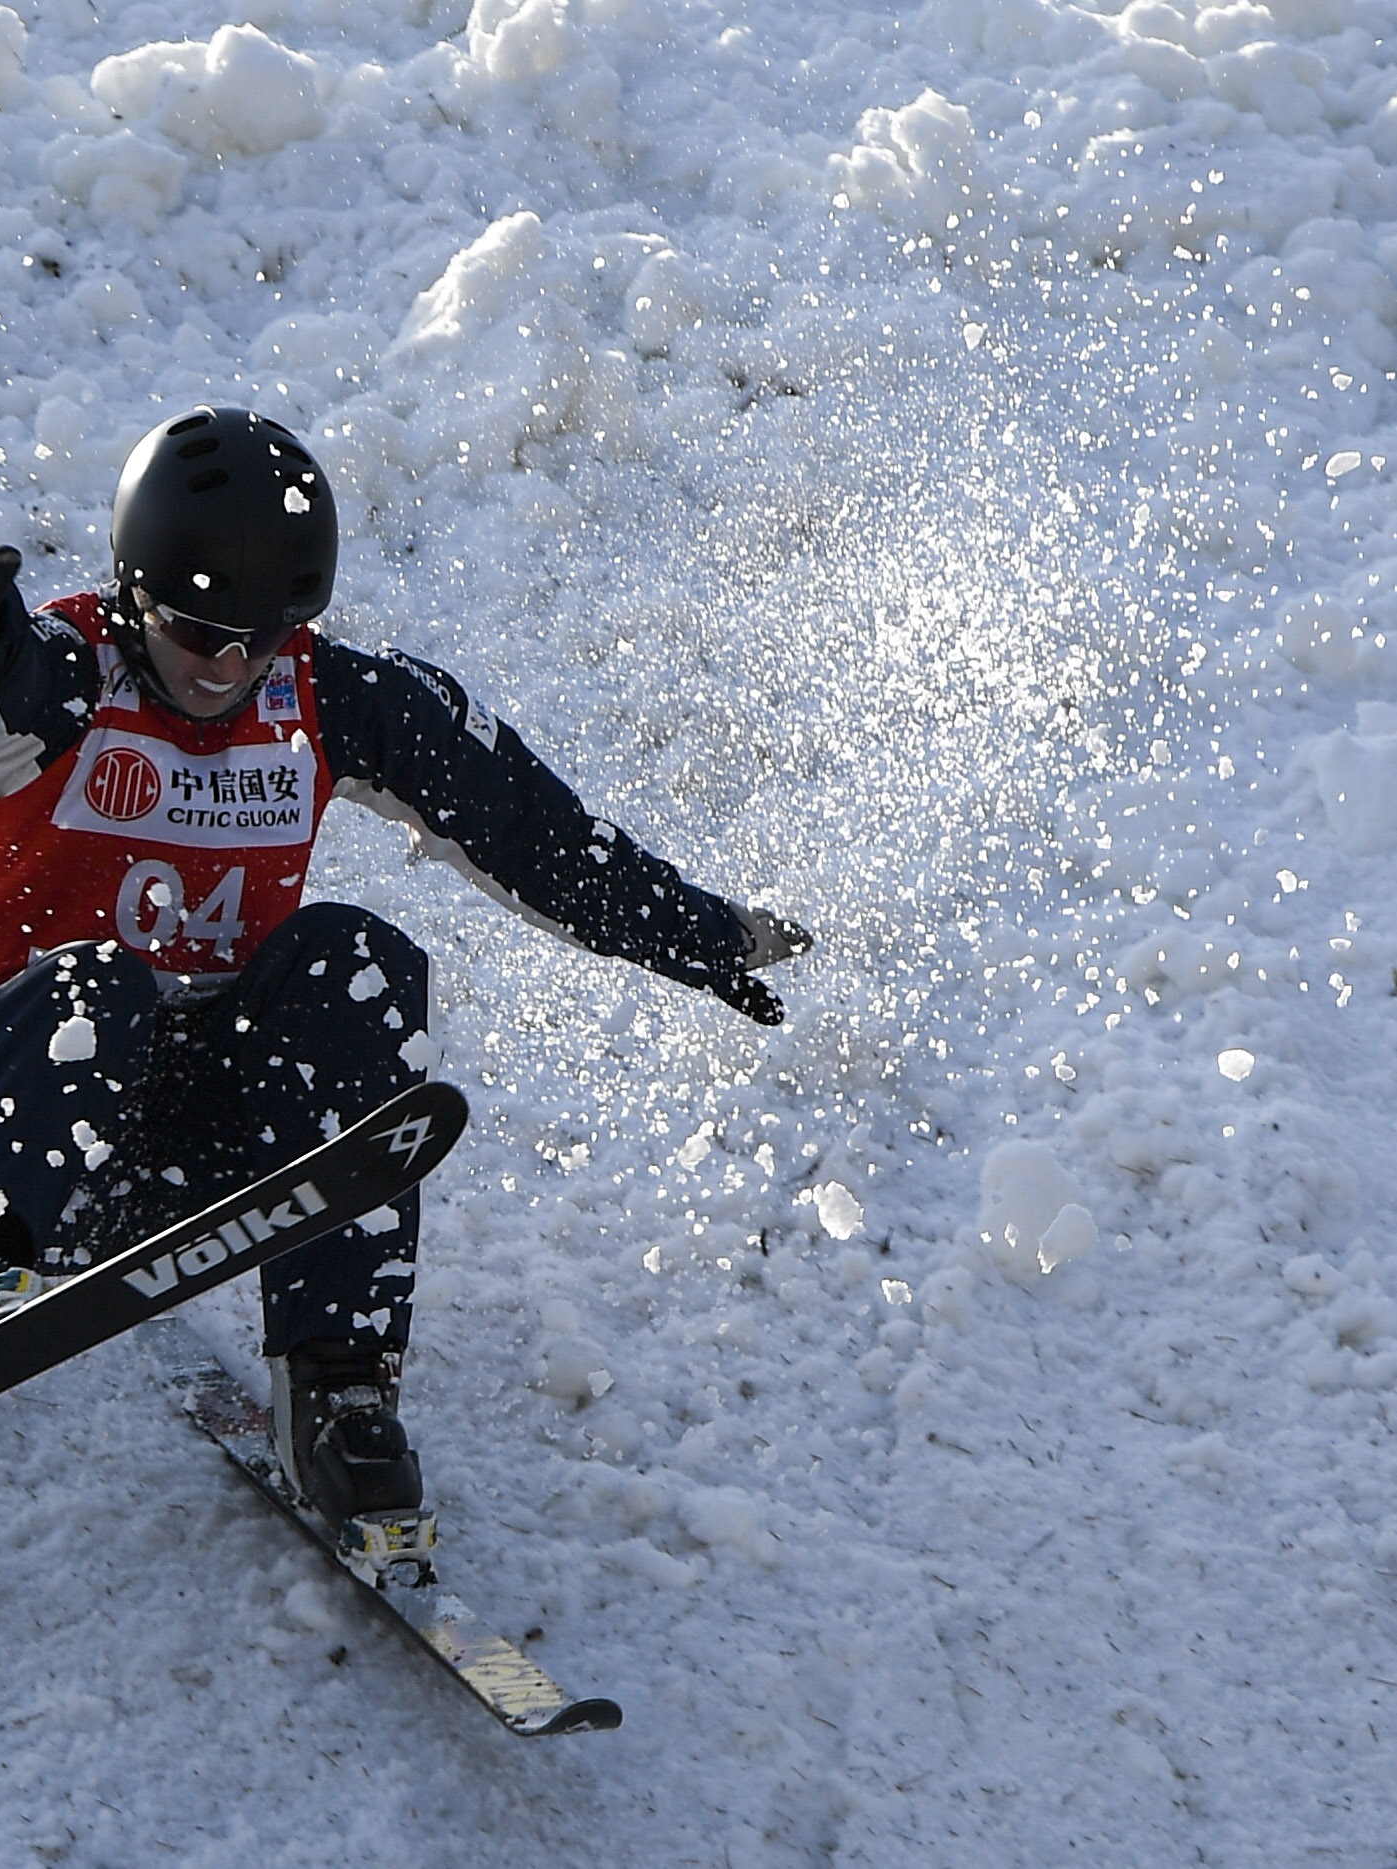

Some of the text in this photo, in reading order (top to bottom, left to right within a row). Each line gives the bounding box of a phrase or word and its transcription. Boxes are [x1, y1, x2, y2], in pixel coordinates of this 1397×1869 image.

[171, 765, 299, 804] 中信国安
[167, 807, 301, 828] CITIC GUOAN
[115, 858, 246, 958] 04
